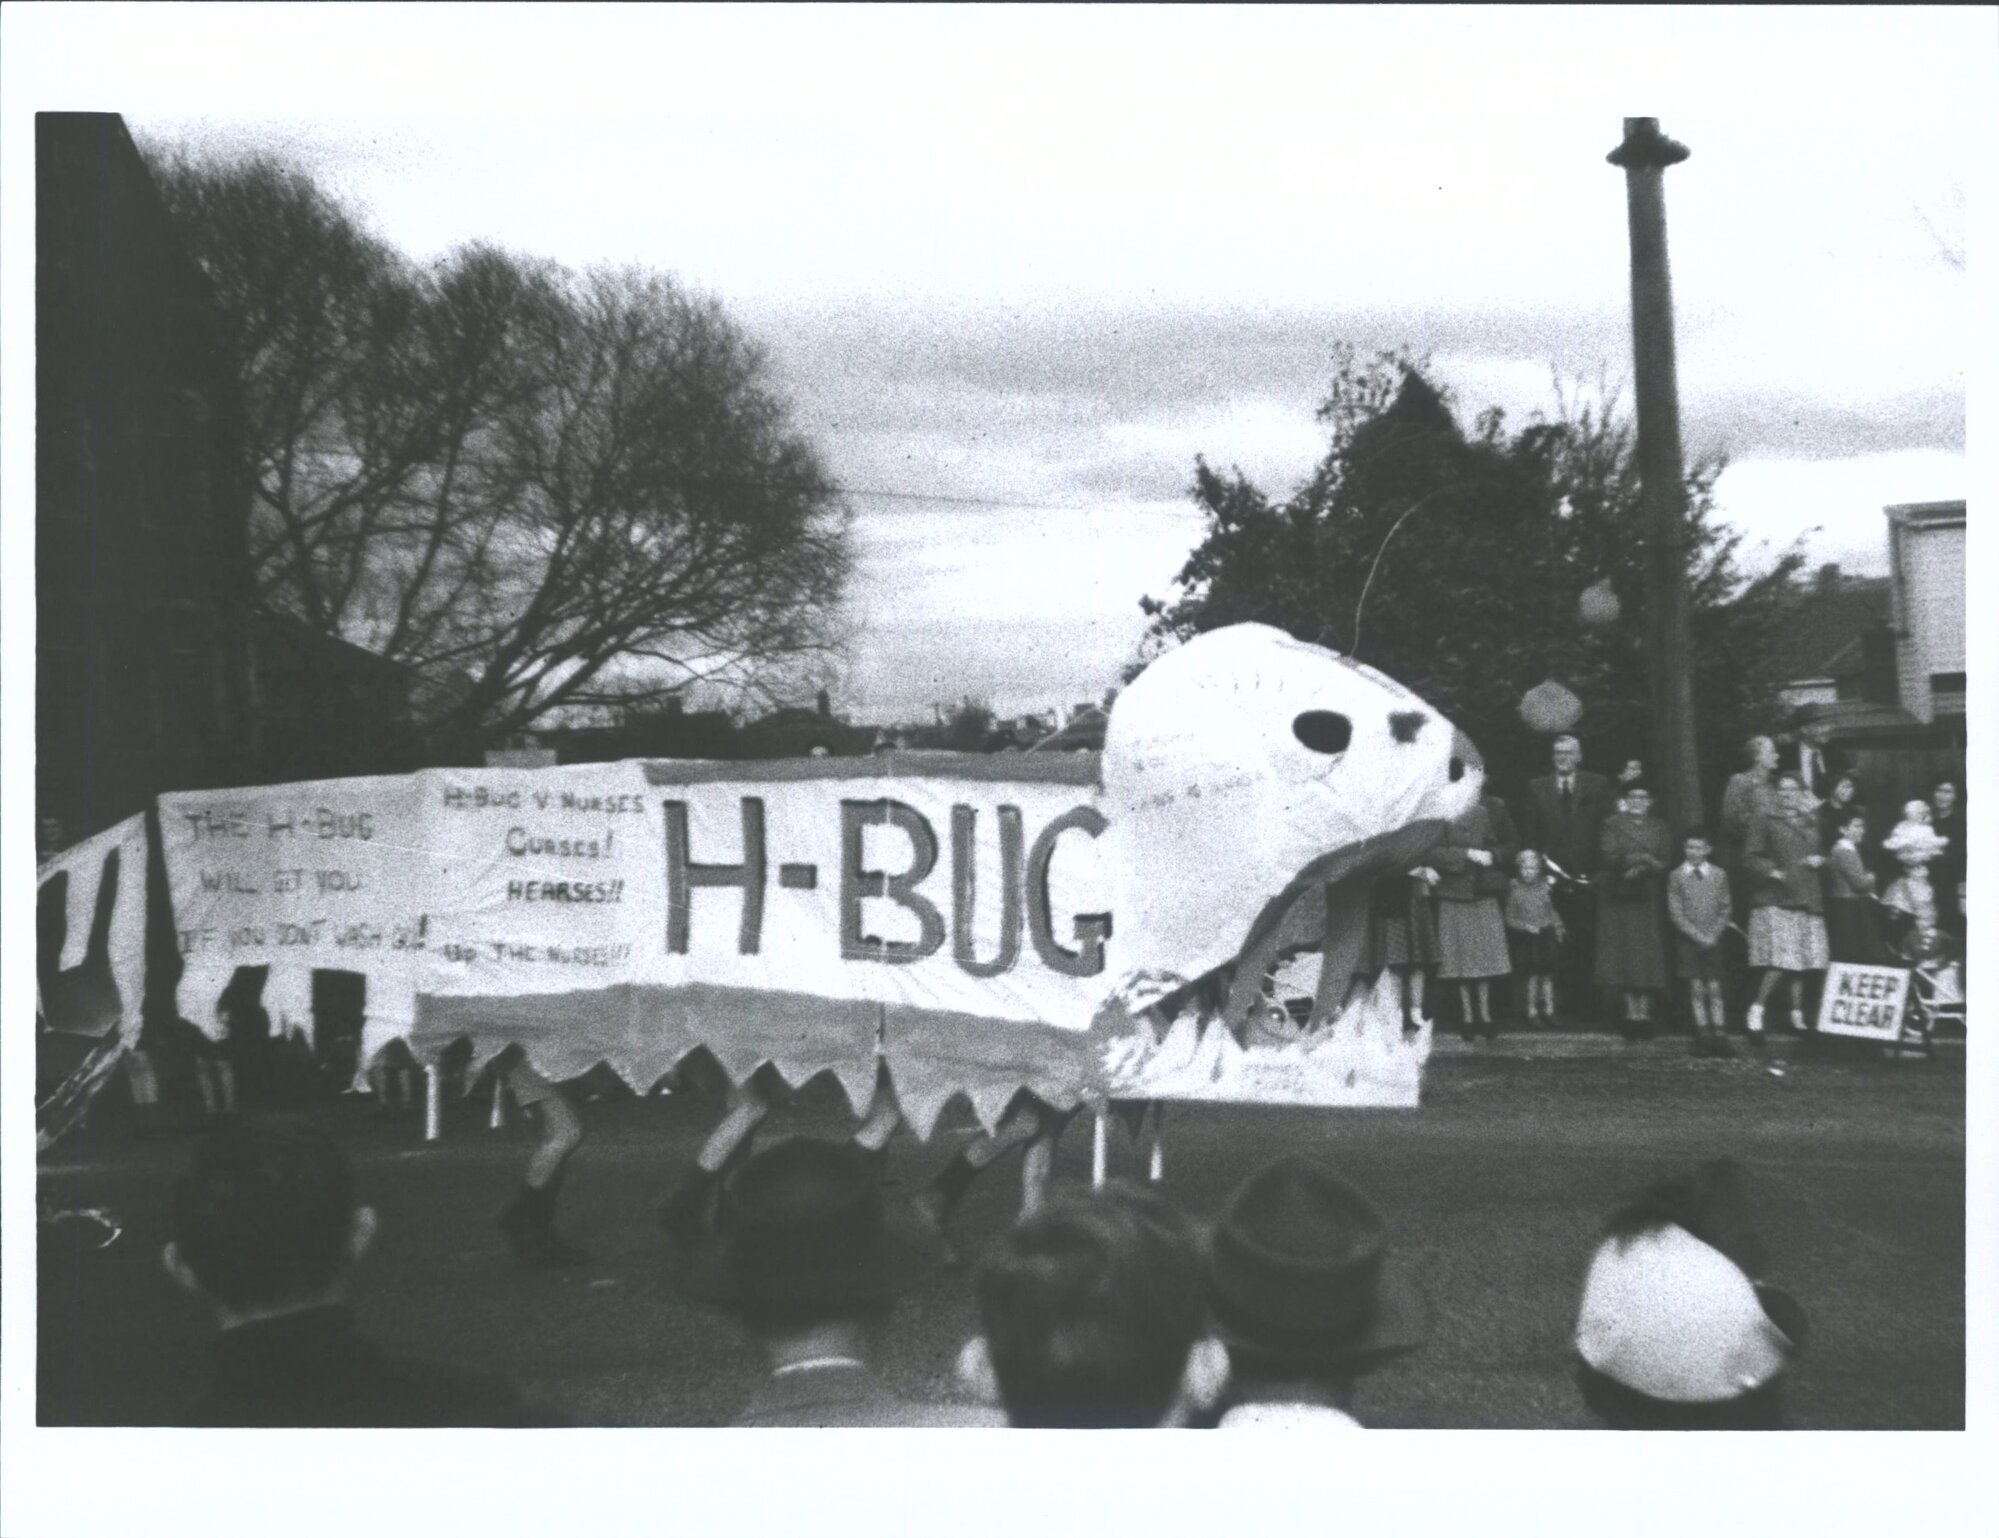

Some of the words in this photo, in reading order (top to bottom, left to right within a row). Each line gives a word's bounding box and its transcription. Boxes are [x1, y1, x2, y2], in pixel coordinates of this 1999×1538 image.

[663, 796, 1113, 977] H-BUG
[1838, 972, 1899, 999] KEEP
[1829, 999, 1896, 1029] CLEAR
